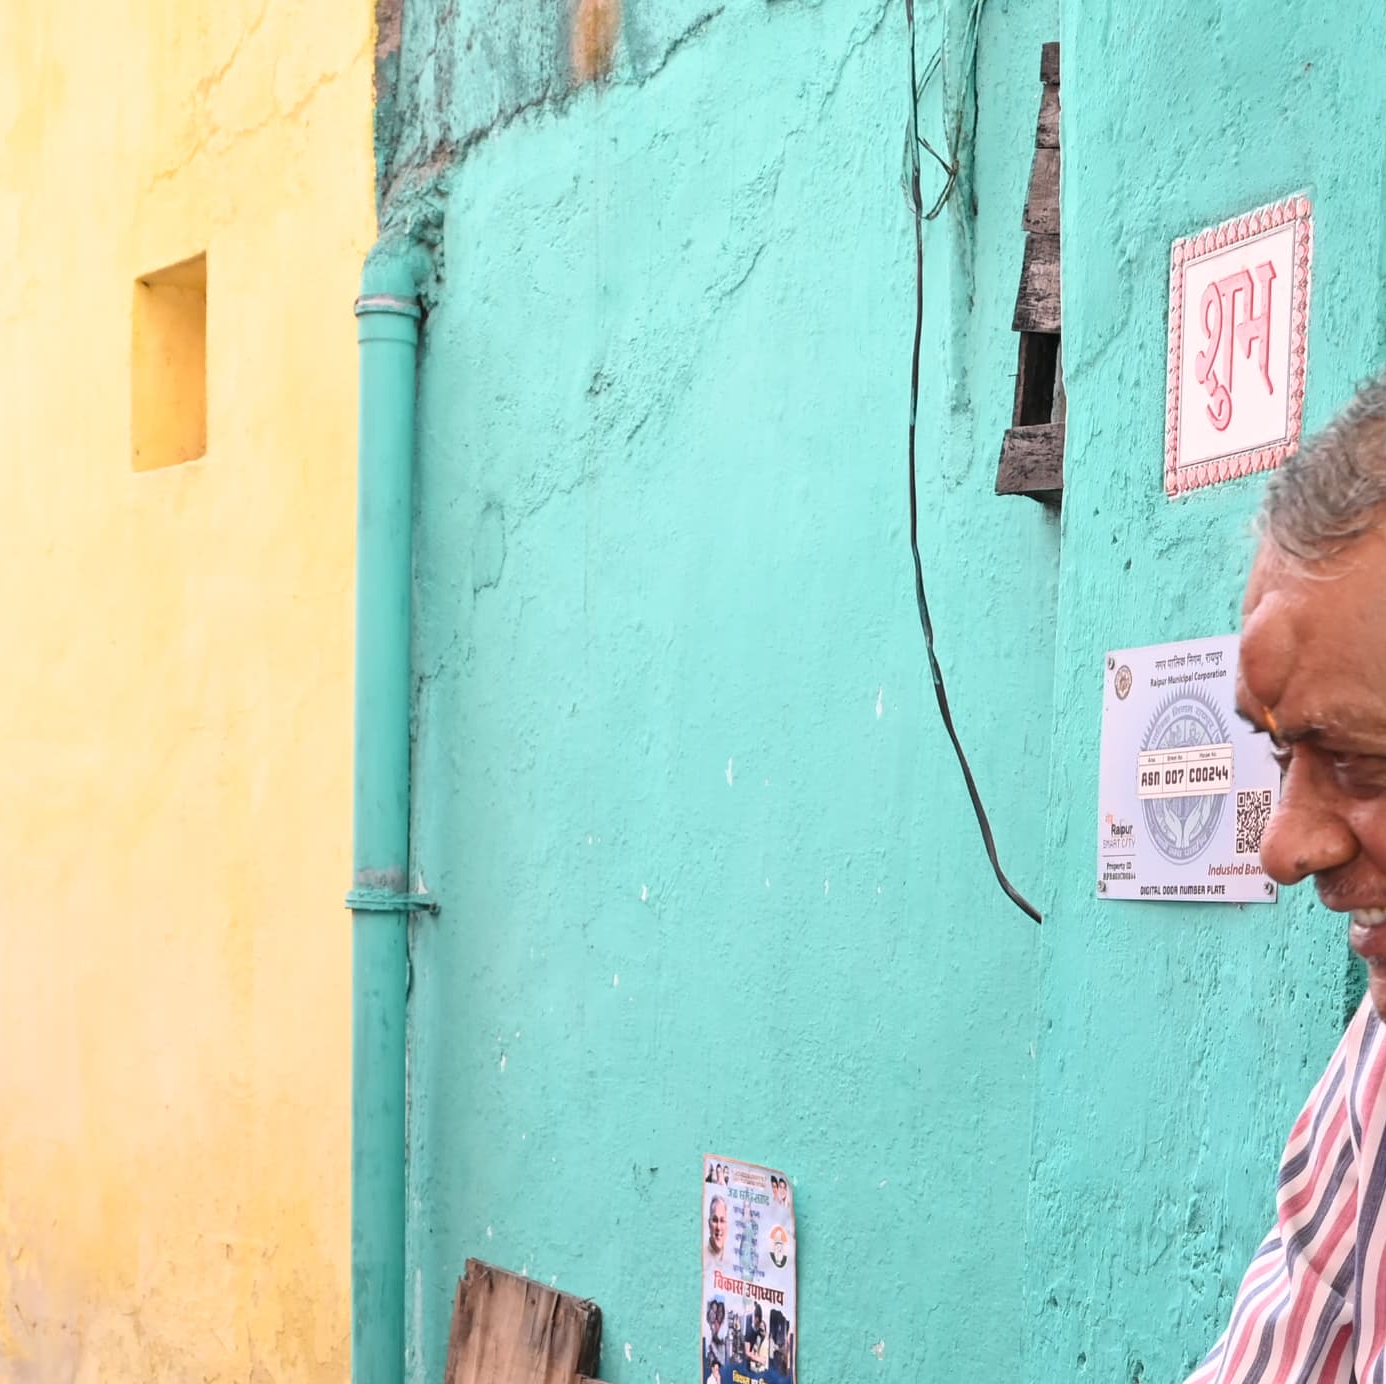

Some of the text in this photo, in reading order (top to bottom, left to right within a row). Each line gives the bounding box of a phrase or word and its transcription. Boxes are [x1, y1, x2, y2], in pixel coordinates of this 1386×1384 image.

[1195, 259, 1277, 432] शुभ
[1167, 655, 1186, 670] पालिक
[1205, 651, 1223, 666] रायपुर
[1150, 669, 1227, 688] Raipur Municipal Corporation
[1165, 769, 1184, 785] 007
[1111, 824, 1133, 837] Raipur
[1103, 838, 1136, 849] SMART CITY
[1208, 863, 1244, 875] IndusInd
[1140, 885, 1226, 895] DIGITAL DOOR NUMBER PLATE
[714, 1270, 784, 1306] विकास उपाध्याय
